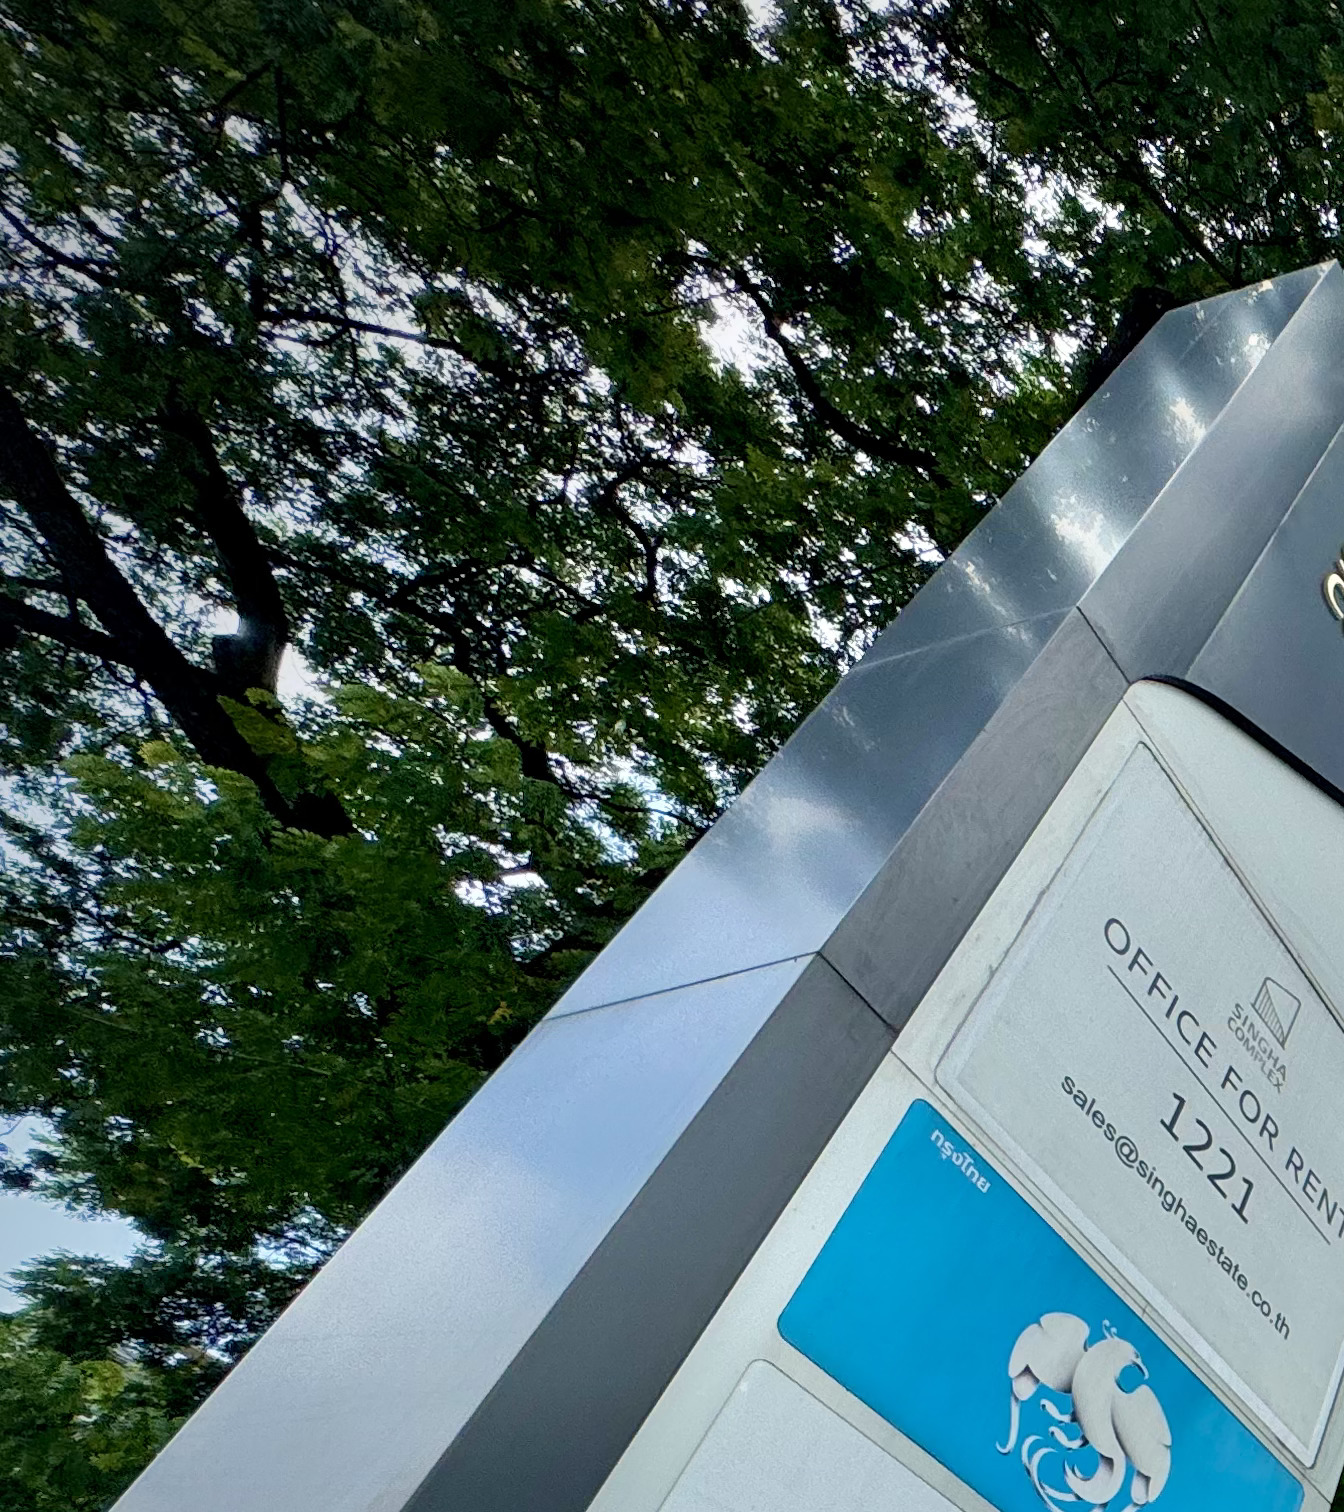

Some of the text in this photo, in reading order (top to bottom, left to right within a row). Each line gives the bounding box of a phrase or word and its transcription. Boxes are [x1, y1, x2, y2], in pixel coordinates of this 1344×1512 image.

[1103, 917, 1217, 1068] OFFICE
[1220, 1065, 1279, 1151] FOR
[1227, 1016, 1283, 1094] COMPLEX
[1232, 1003, 1287, 1082] SINGHA
[930, 1129, 991, 1193] กรุงไทย
[1060, 1075, 1291, 1341] sales@singhaestate.co.th
[1160, 1092, 1255, 1224] 1221
